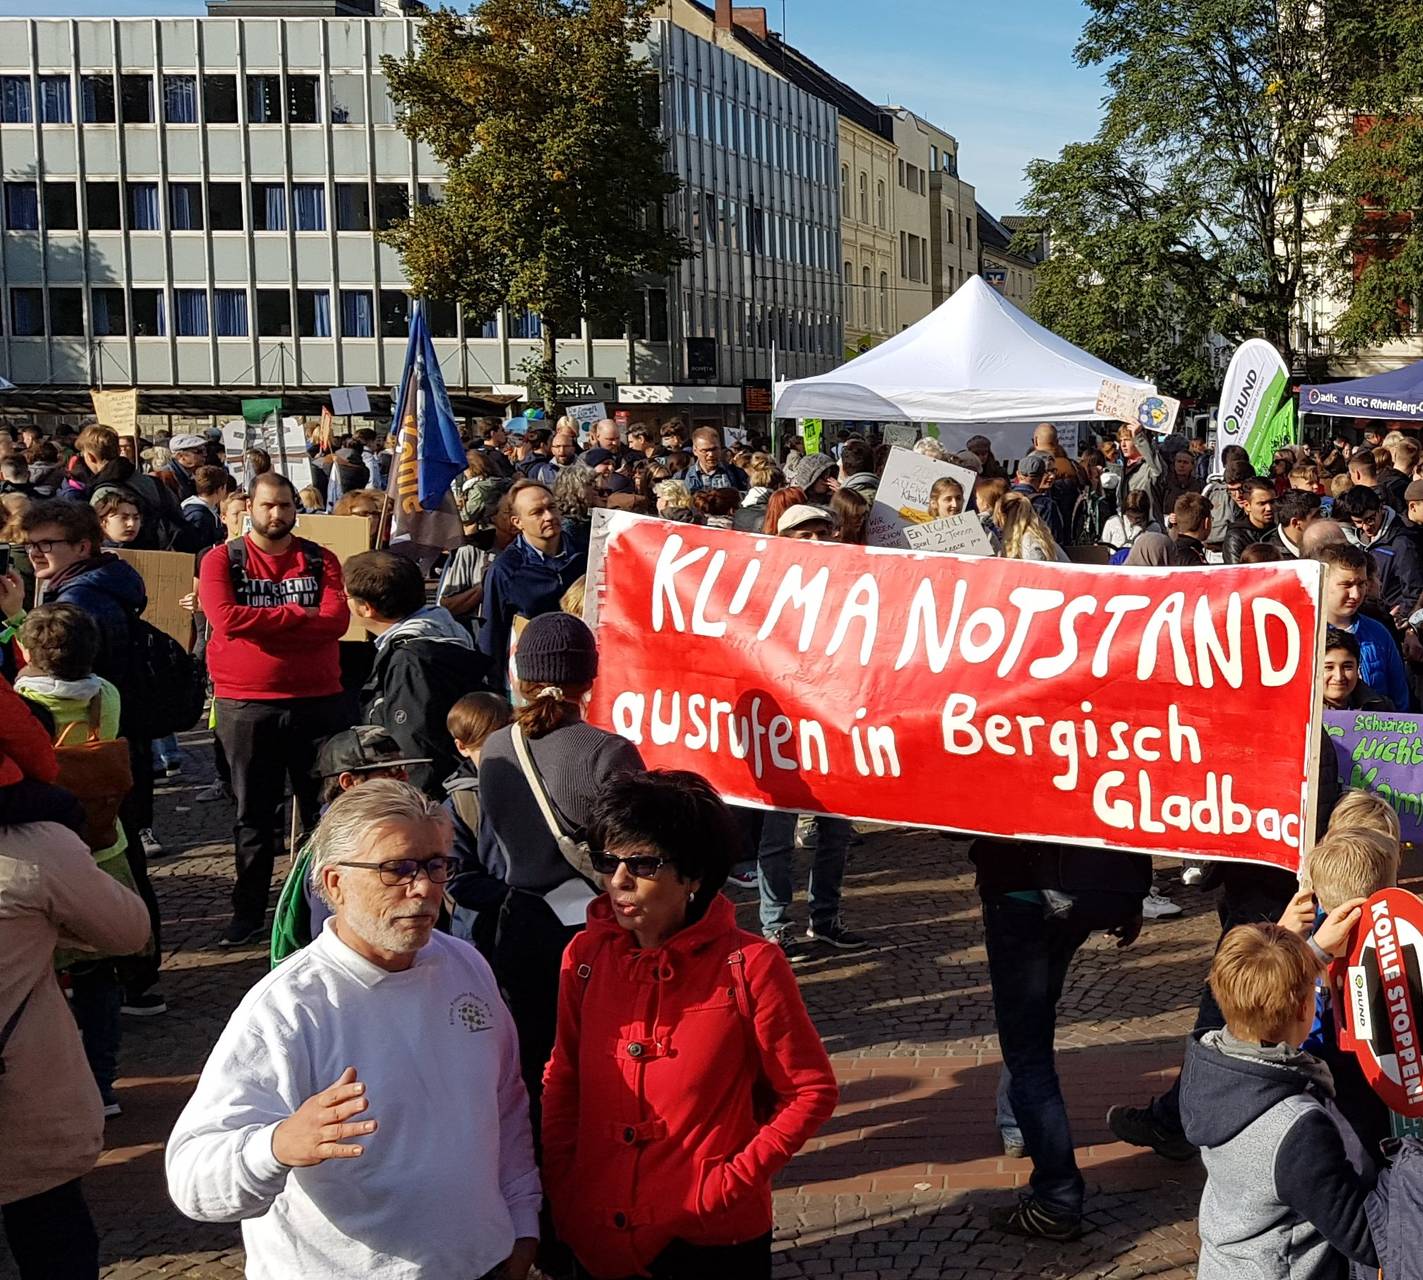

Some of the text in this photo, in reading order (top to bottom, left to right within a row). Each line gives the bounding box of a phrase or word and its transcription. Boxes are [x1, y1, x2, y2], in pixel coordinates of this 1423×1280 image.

[1234, 369, 1258, 419] BUND
[1344, 395, 1369, 408] ADFC
[612, 688, 1202, 791] ausrufen in Bergisch
[1371, 900, 1400, 982] KOHLE
[1356, 990, 1366, 1027] BUND
